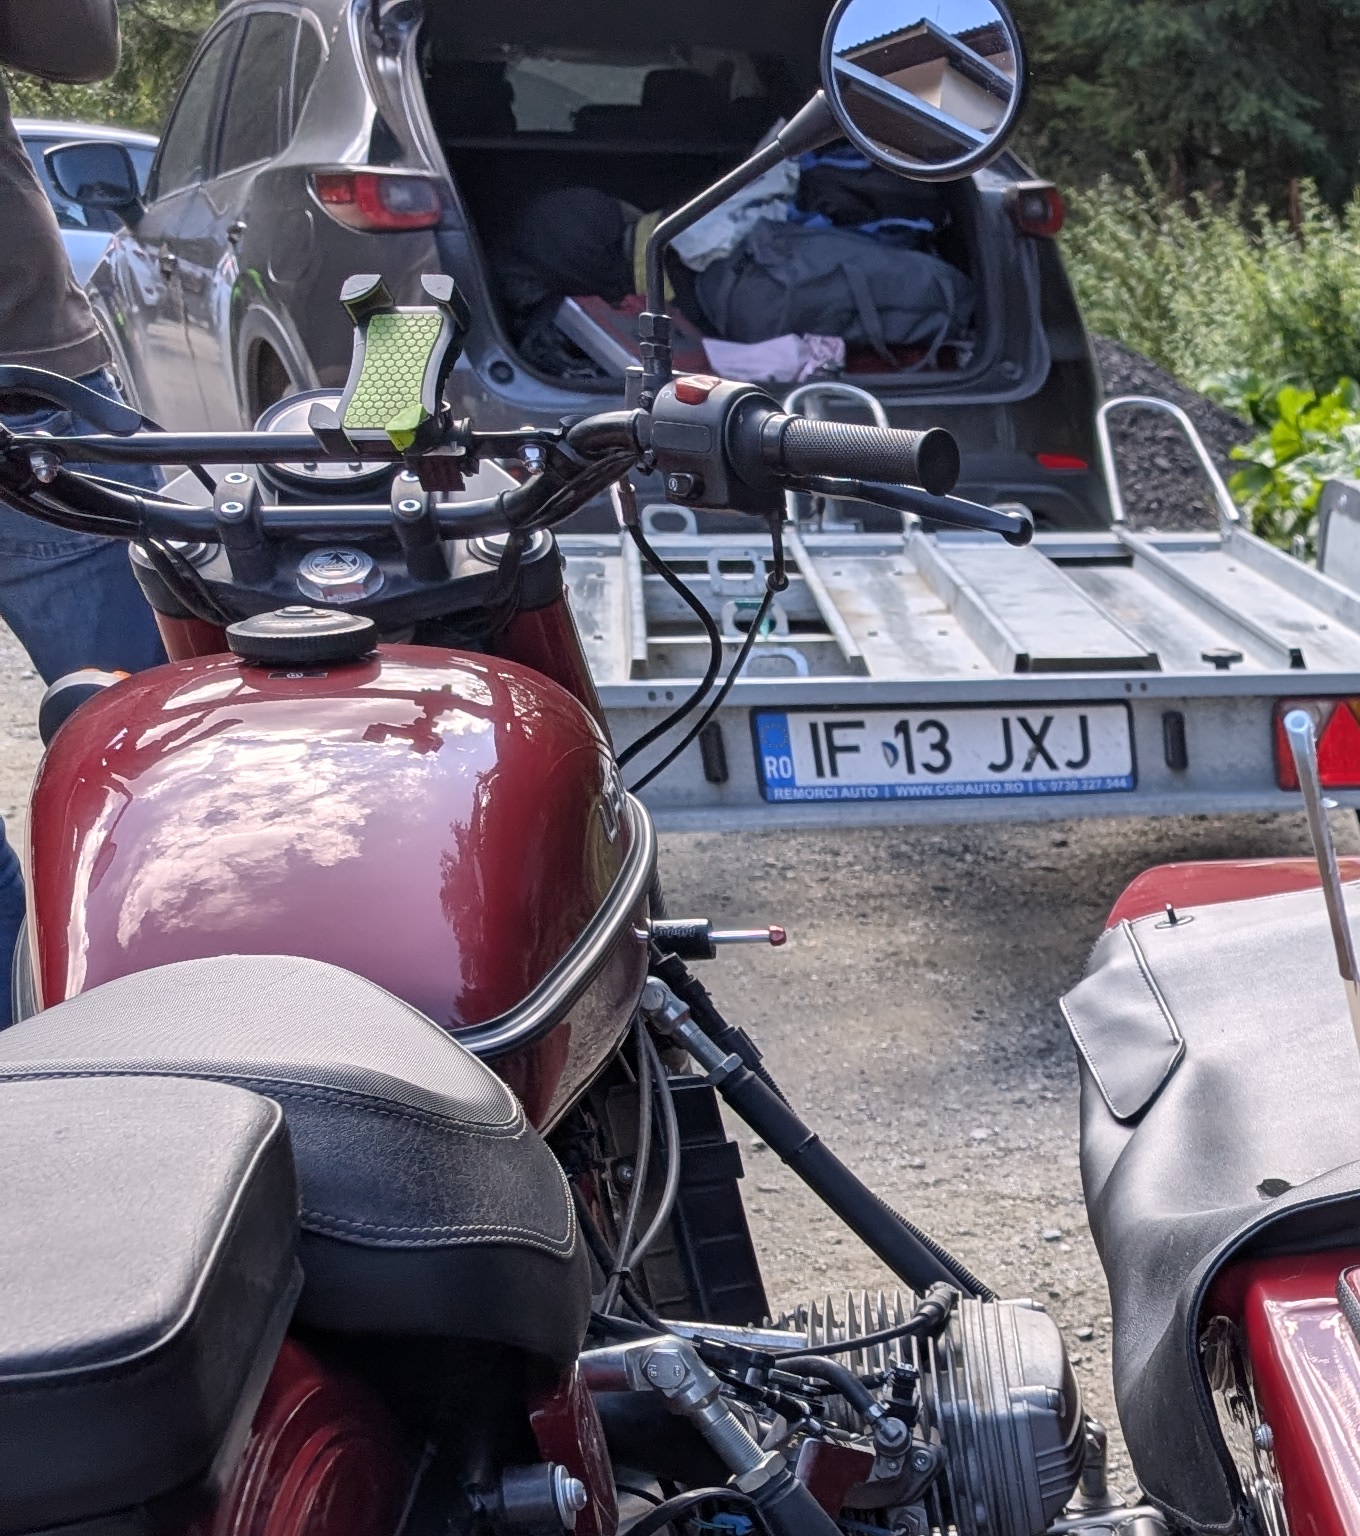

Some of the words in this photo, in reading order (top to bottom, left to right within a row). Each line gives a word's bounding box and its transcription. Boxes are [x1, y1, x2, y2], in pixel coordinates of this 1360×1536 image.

[808, 720, 866, 778] IF
[893, 719, 953, 775] 13
[987, 715, 1092, 773] JXJ
[764, 756, 793, 779] RO
[773, 787, 839, 800] REMORCI
[840, 786, 878, 799] AUTO
